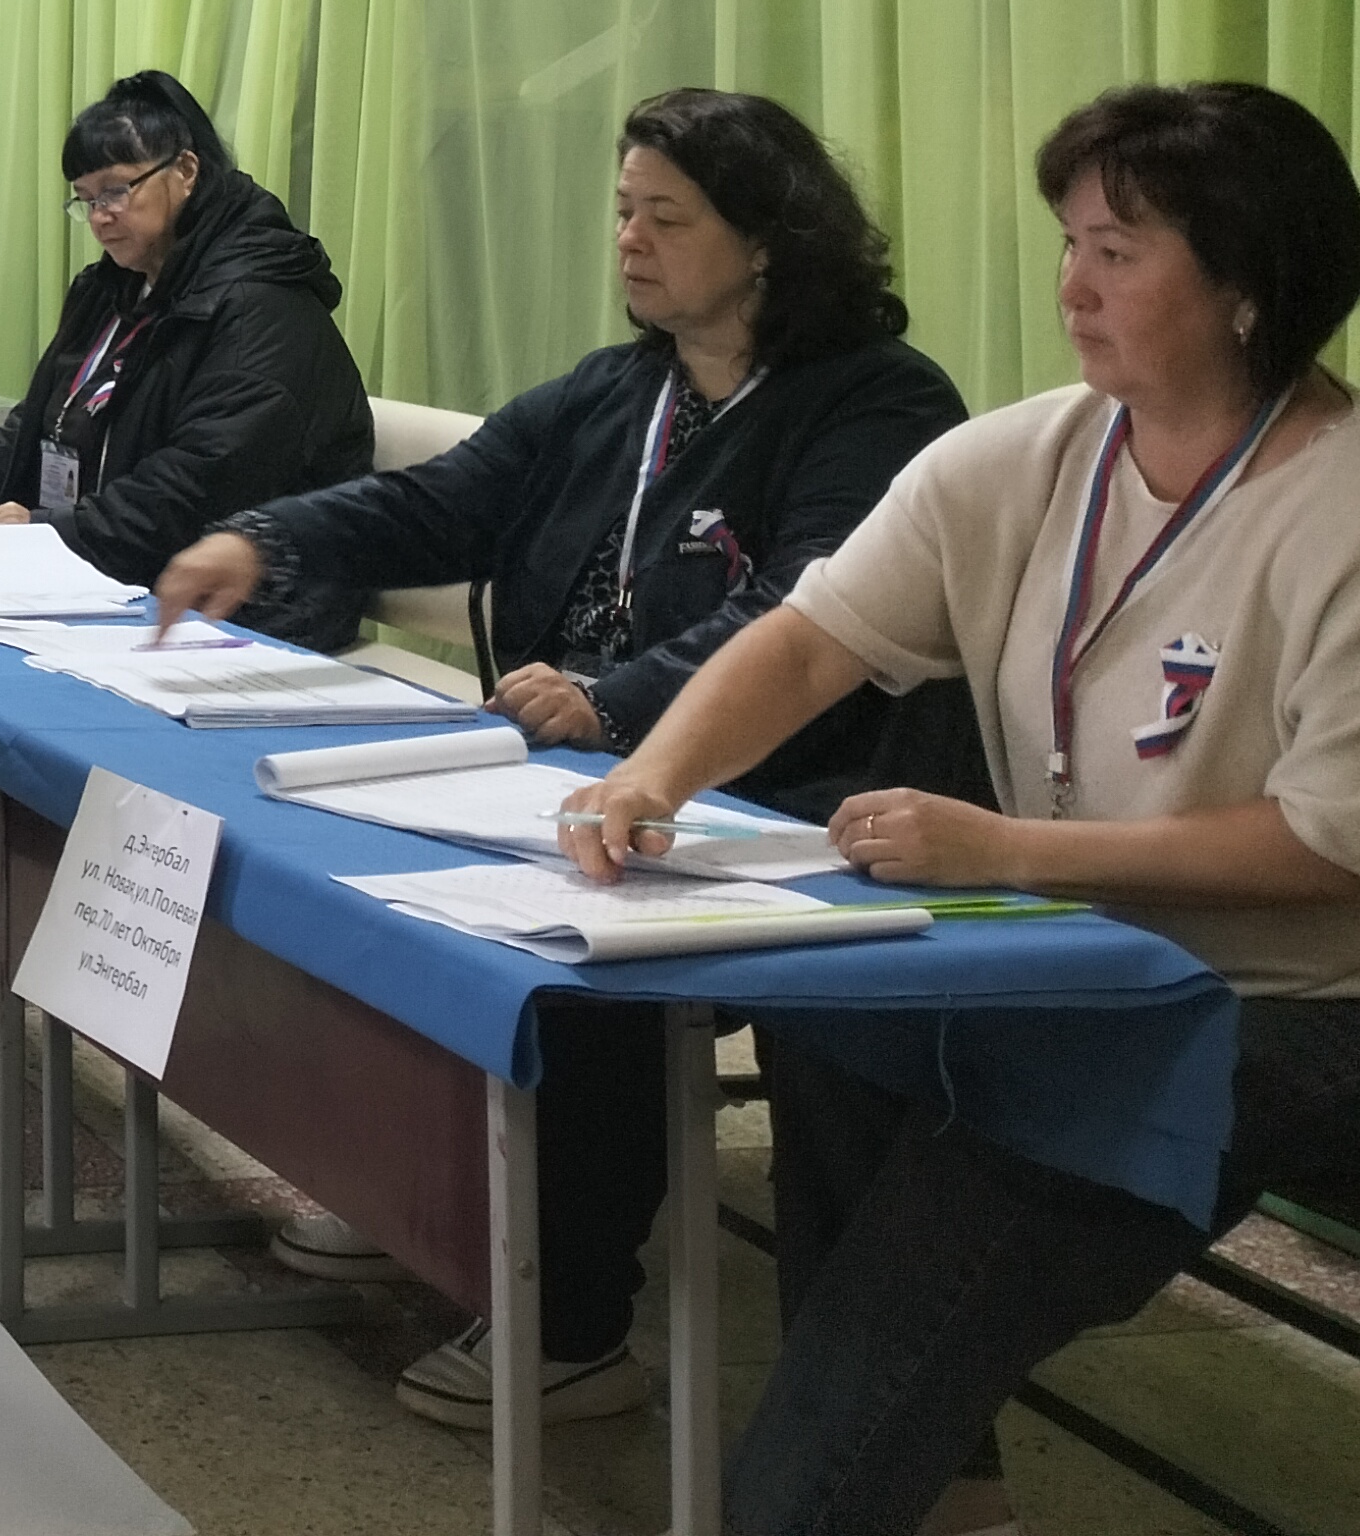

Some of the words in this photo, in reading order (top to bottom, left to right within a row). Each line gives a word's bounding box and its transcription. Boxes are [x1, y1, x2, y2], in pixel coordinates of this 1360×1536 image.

[81, 858, 102, 880] ул.
[122, 834, 191, 875] д.Энгербал
[110, 918, 133, 942] лет
[131, 925, 183, 968] Октября
[78, 950, 149, 1001] ул.Энгербал
